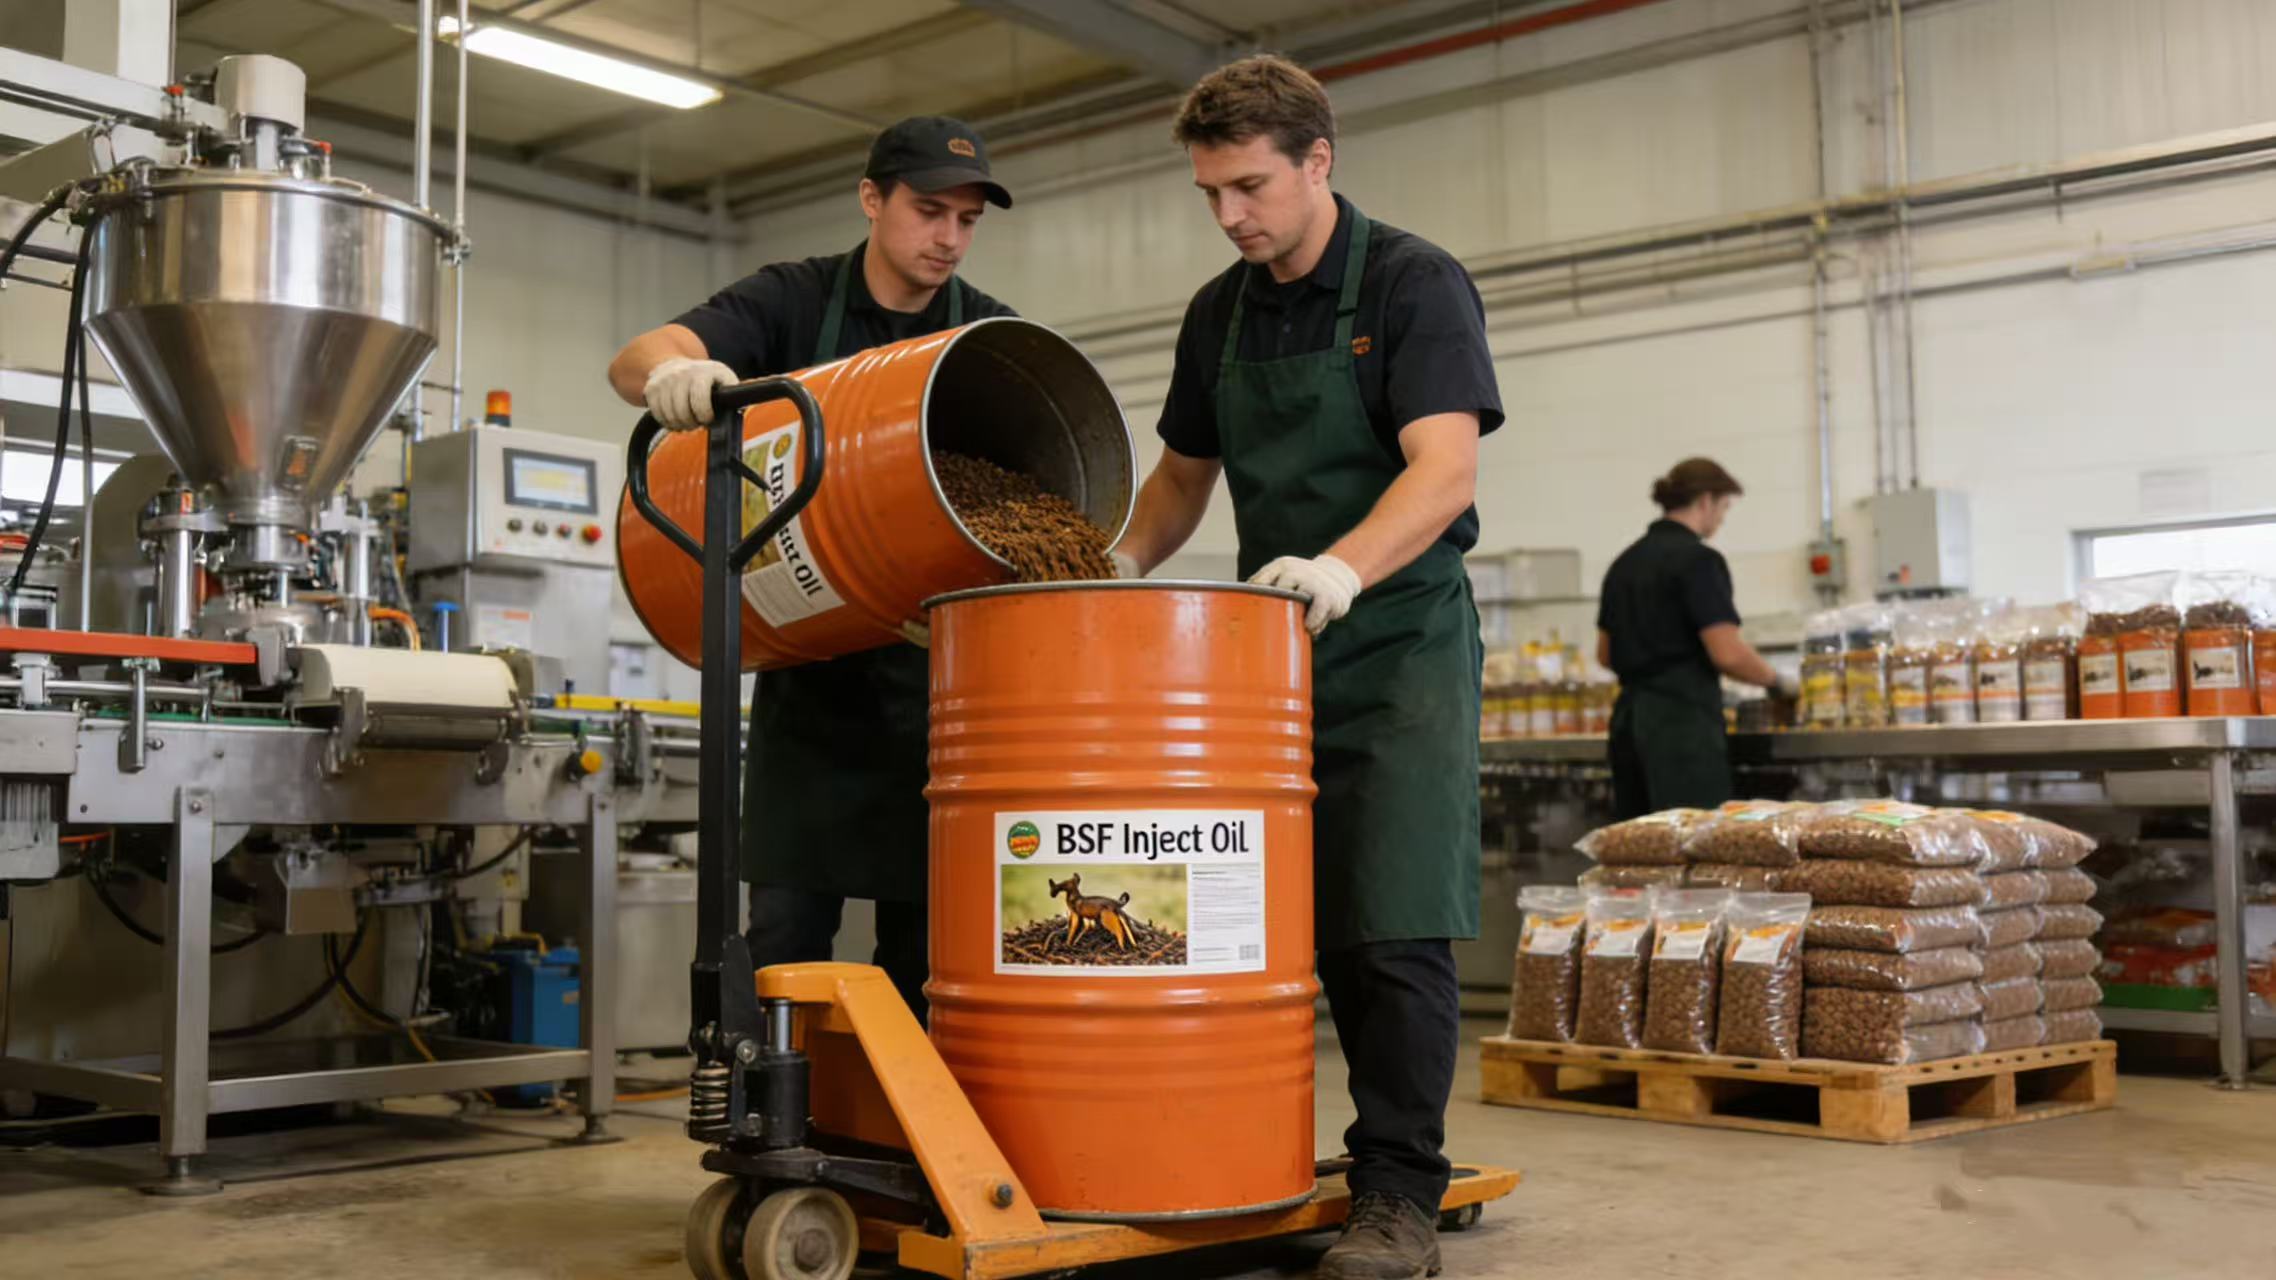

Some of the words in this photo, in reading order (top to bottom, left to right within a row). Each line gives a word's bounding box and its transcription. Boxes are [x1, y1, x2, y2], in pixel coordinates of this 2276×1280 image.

[1057, 823, 1114, 855] BSF
[1124, 823, 1203, 860] Inject
[1211, 821, 1249, 854] Oil
